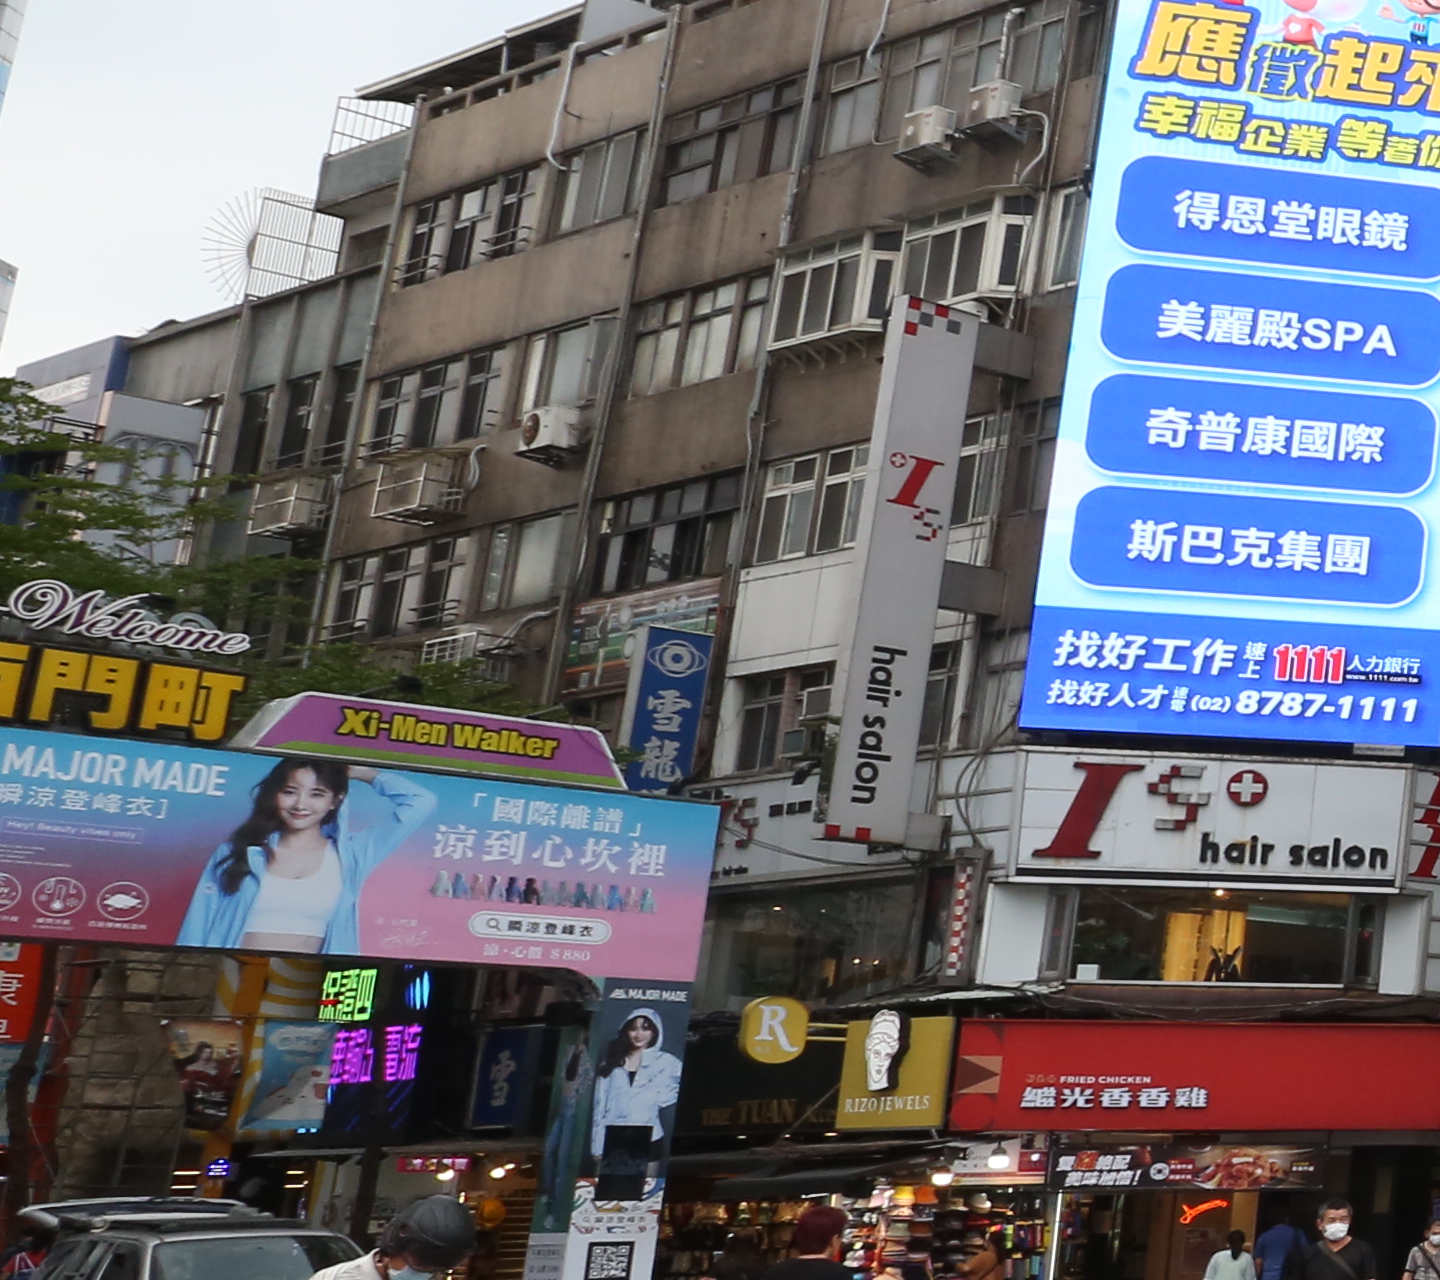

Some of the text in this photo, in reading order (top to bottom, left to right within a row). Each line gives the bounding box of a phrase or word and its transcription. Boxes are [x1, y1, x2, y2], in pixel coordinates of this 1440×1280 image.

[1174, 189, 1411, 251] 得恩堂眼鏡
[1156, 300, 1398, 358] 美麗殿SPA
[1144, 405, 1385, 464] 奇普康國際
[1127, 518, 1371, 576] 斯巴克集團
[8, 579, 250, 654] Welcome
[1055, 628, 1235, 675] 找好工作
[1273, 642, 1346, 683] 1111
[1346, 654, 1421, 675] 人力銀行
[850, 645, 908, 805] hair salon
[1047, 677, 1418, 724] 找好人才 (02) 8787-1111
[337, 708, 558, 760] Xi-Men Walker
[636, 690, 694, 793] 雪龍
[3, 742, 230, 797] MAJOR MADE
[472, 793, 644, 838] 「國際離譜」
[432, 823, 668, 879] 涼到心坎裡
[1199, 831, 1389, 870] hair salon
[507, 919, 595, 939] 瞬涼登峰衣
[628, 989, 688, 1003] MAJOR MADE
[844, 1094, 931, 1114] RIZO JEWELS
[1020, 1086, 1209, 1108] 繼光香香雞
[1060, 1075, 1152, 1084] FRIED CHICKEN
